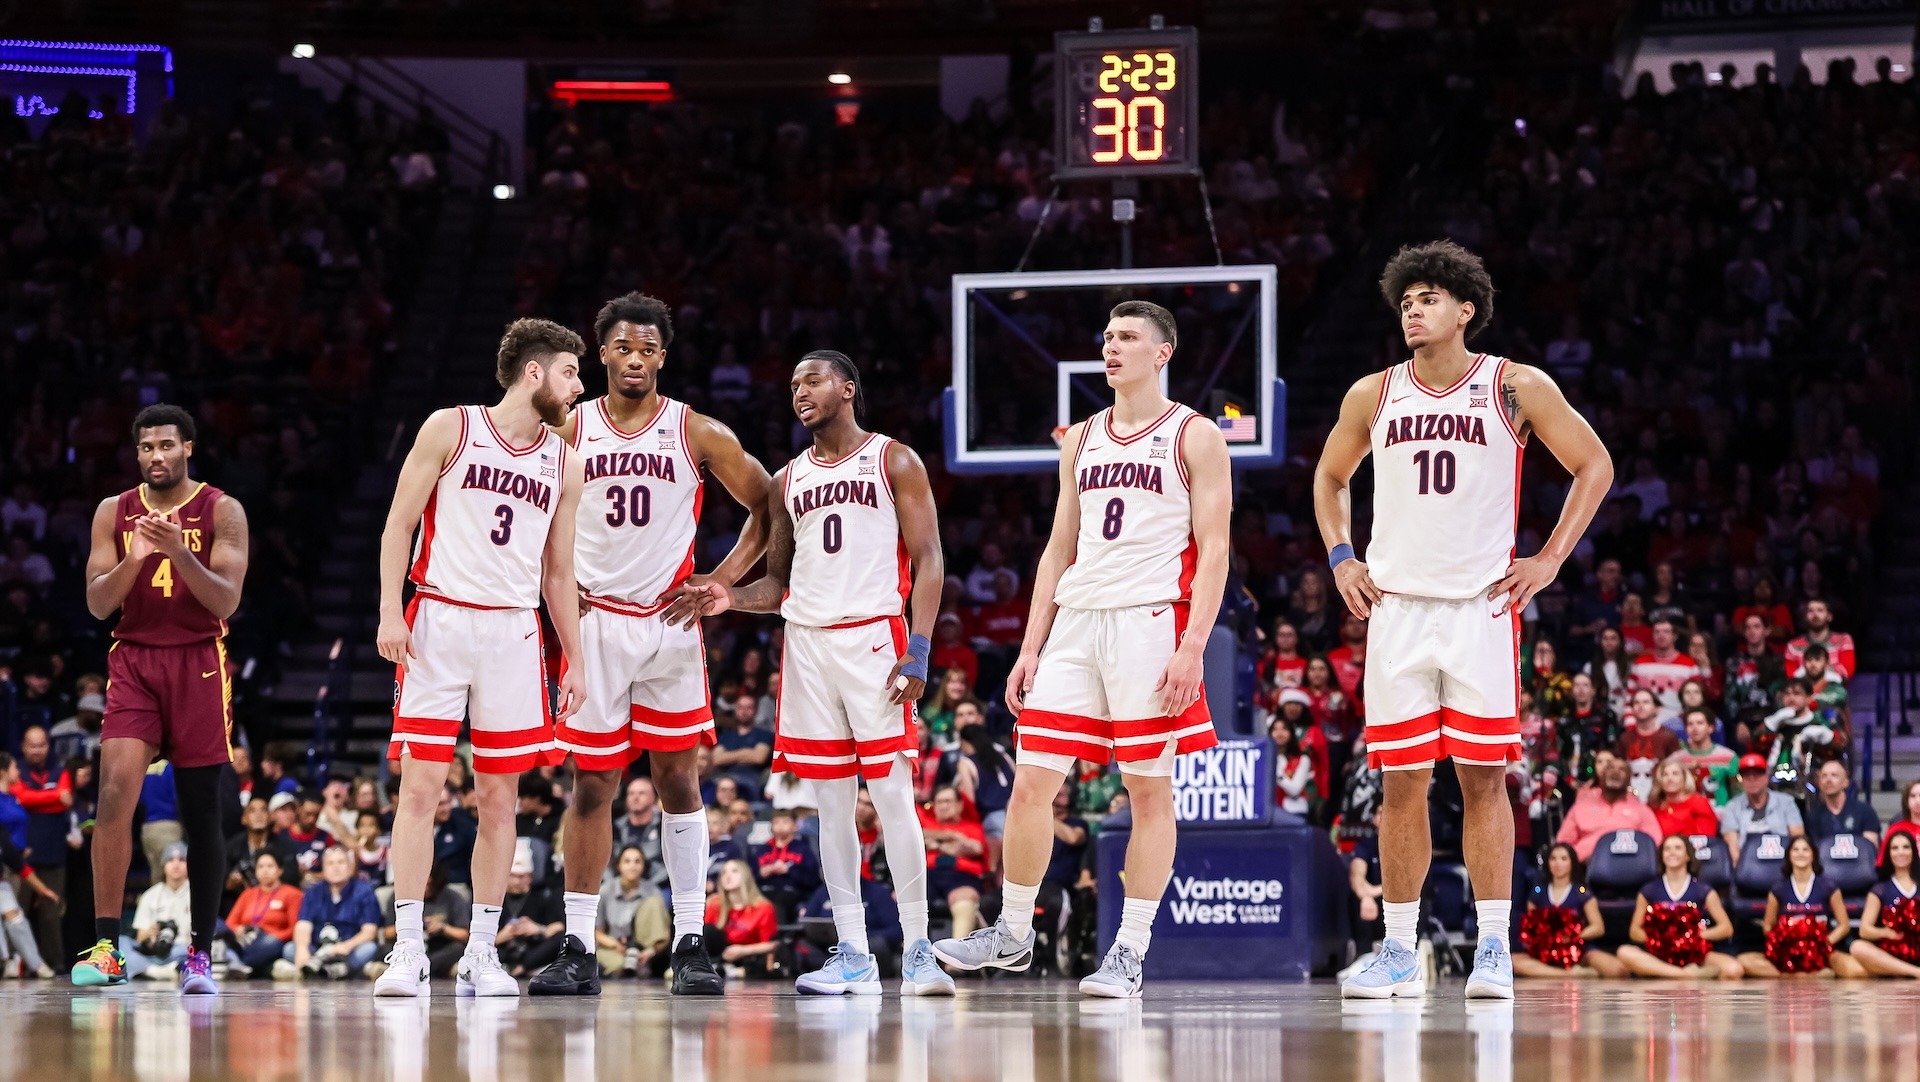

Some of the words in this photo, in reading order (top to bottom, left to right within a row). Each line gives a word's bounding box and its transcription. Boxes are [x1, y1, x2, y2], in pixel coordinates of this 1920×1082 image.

[1099, 52, 1176, 93] 2:23
[1092, 96, 1165, 163] 30
[1384, 413, 1488, 449] ARIZONA
[584, 452, 676, 484] ARIZONA
[1079, 462, 1164, 495] ARIZONA
[1412, 449, 1456, 495] 10
[460, 463, 552, 515] ARIZONA
[605, 484, 651, 528] 30
[793, 480, 879, 523] ARIZONA
[490, 503, 514, 547] 3
[823, 513, 842, 555] 0
[1102, 496, 1125, 541] 8
[151, 558, 174, 598] 4
[1171, 748, 1261, 787] OCKIN'
[1172, 786, 1255, 821] ROTEIN
[1173, 876, 1283, 904] Vantage
[1170, 900, 1238, 925] West
